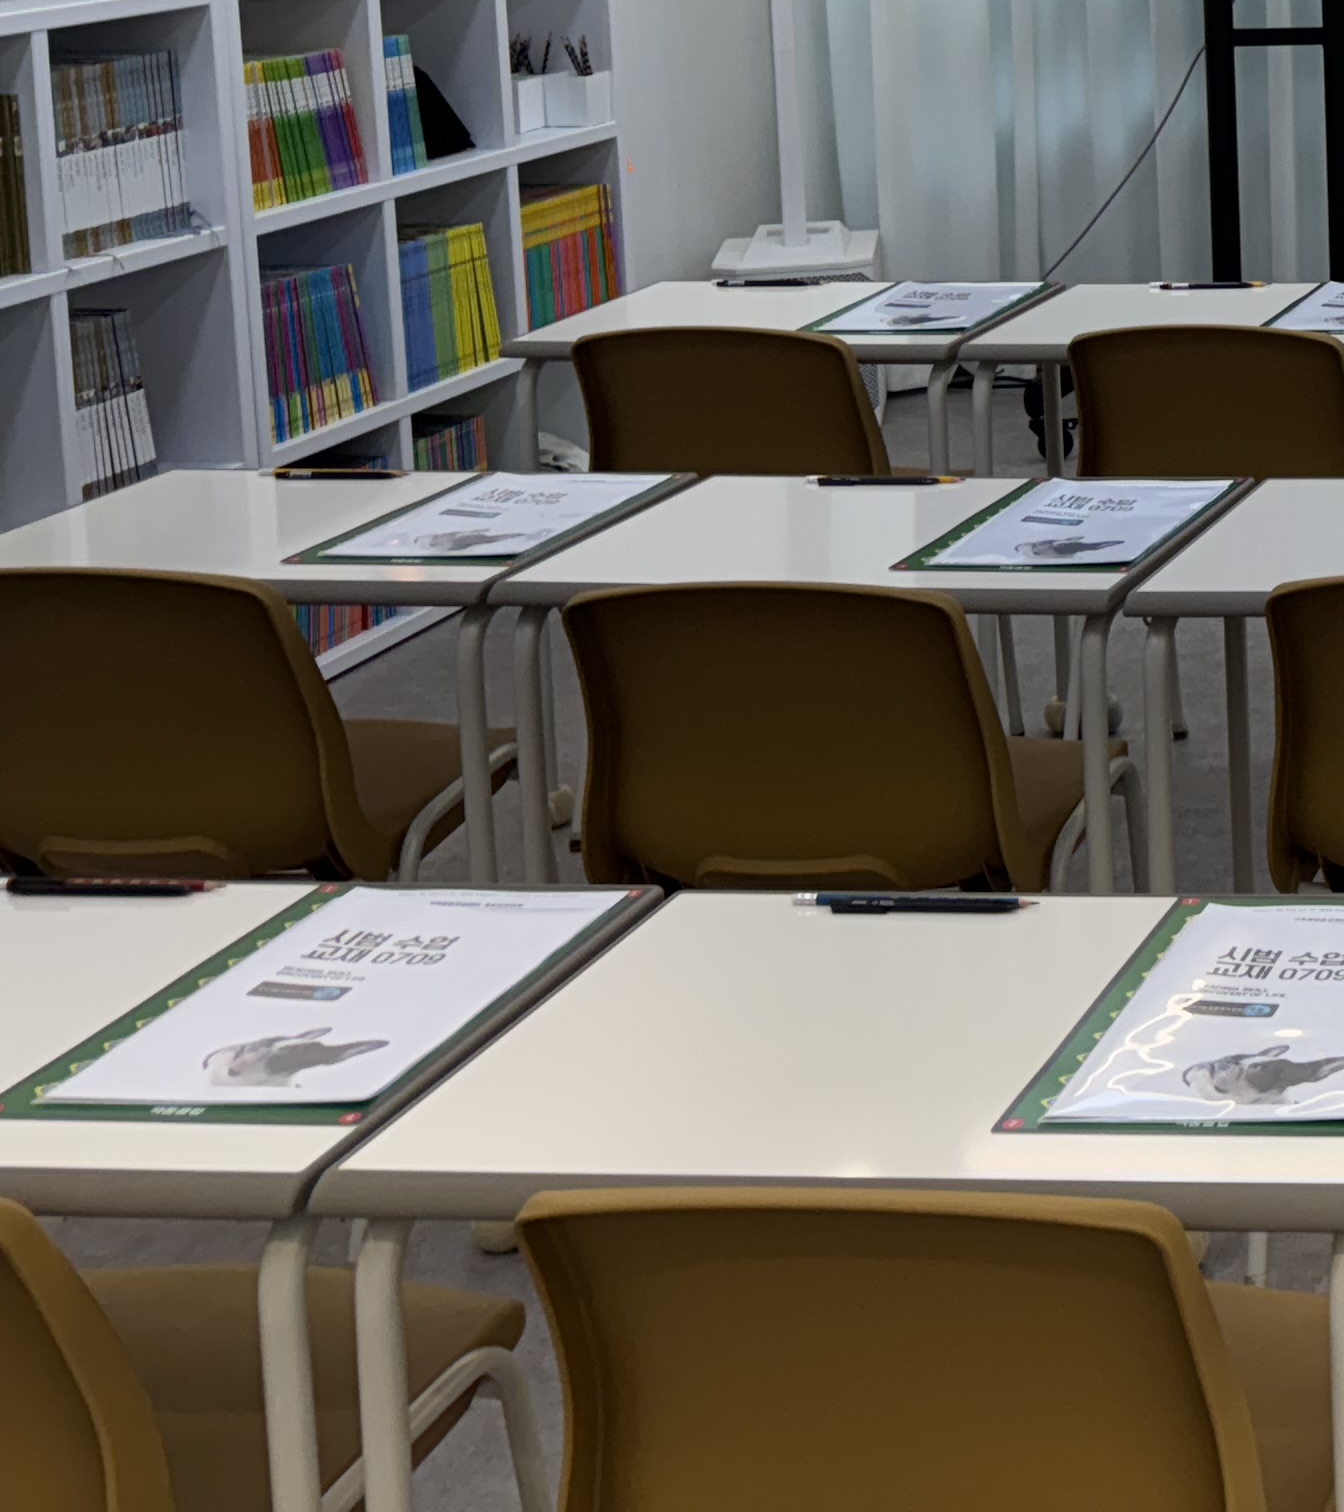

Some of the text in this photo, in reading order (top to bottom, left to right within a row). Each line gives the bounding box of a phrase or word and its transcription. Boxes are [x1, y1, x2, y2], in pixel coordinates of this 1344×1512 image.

[370, 952, 448, 966] 0709
[1217, 945, 1283, 965] 시범
[1206, 960, 1275, 980] 교재
